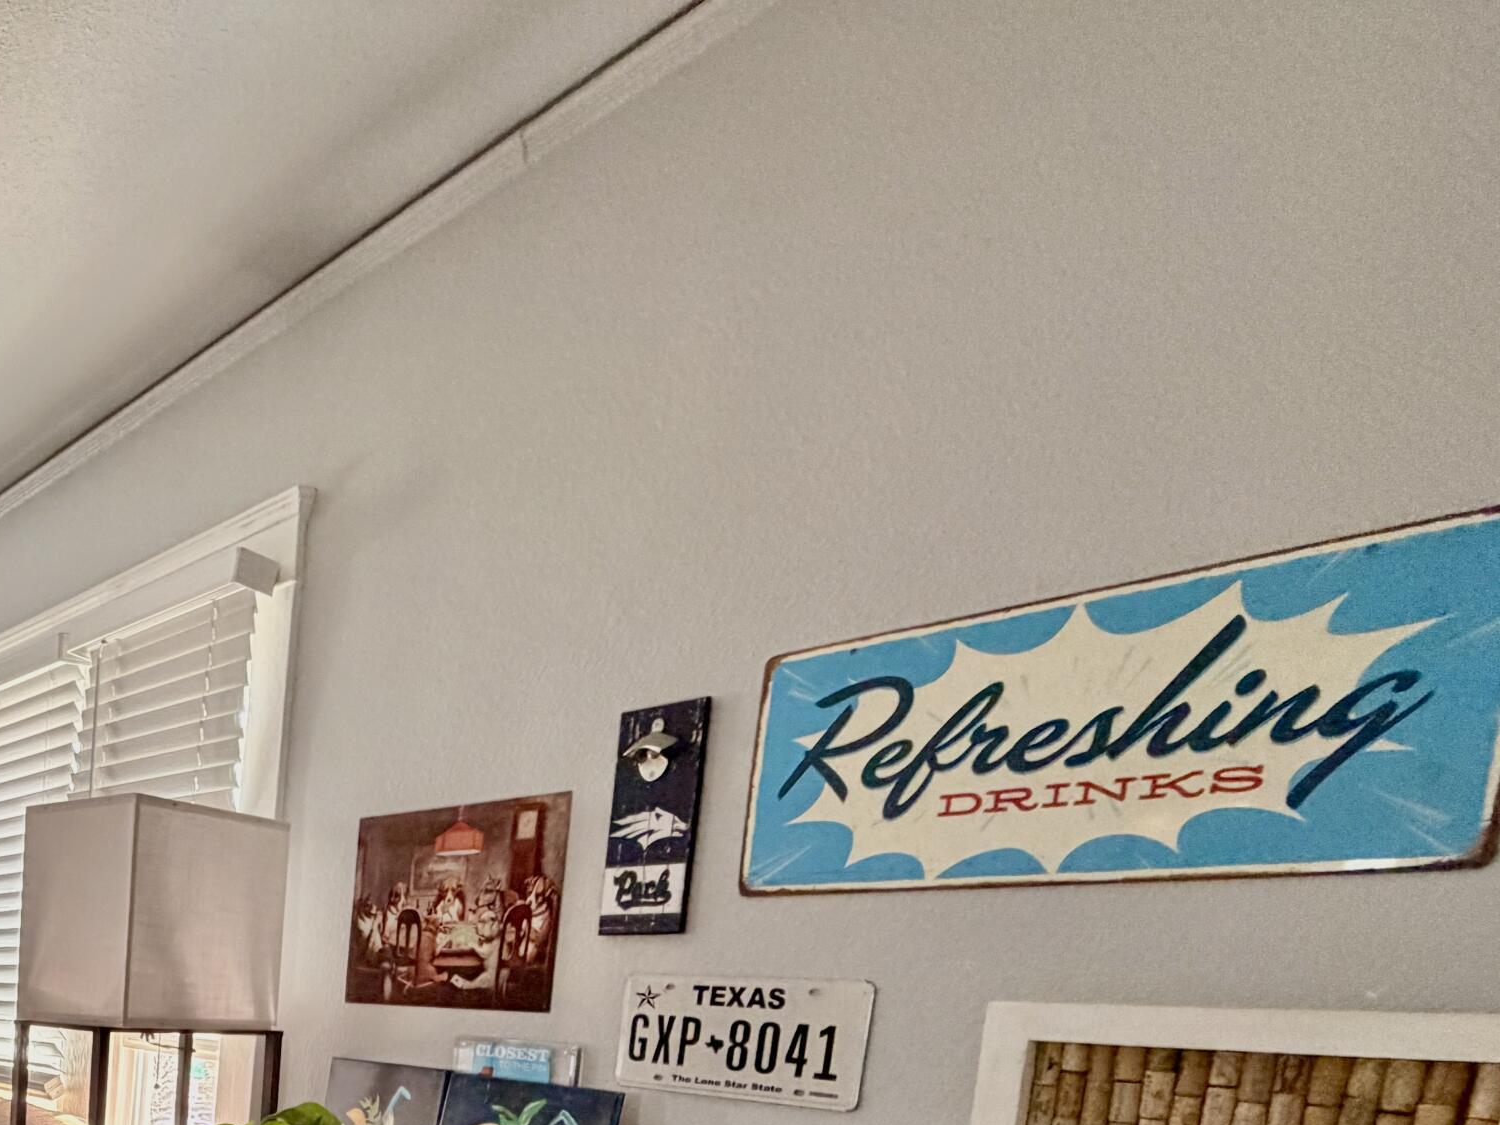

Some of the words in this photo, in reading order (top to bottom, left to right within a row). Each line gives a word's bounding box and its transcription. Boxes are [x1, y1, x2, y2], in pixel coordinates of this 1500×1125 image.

[777, 613, 1434, 821] Refreshing
[936, 764, 1266, 818] DRINKS
[613, 868, 672, 911] Pack
[693, 985, 786, 1010] TEXAS
[475, 1043, 550, 1063] CLOSEST
[671, 1073, 691, 1085] The
[694, 1075, 721, 1087] Lone
[724, 1079, 748, 1091] Star
[751, 1082, 783, 1094] State
